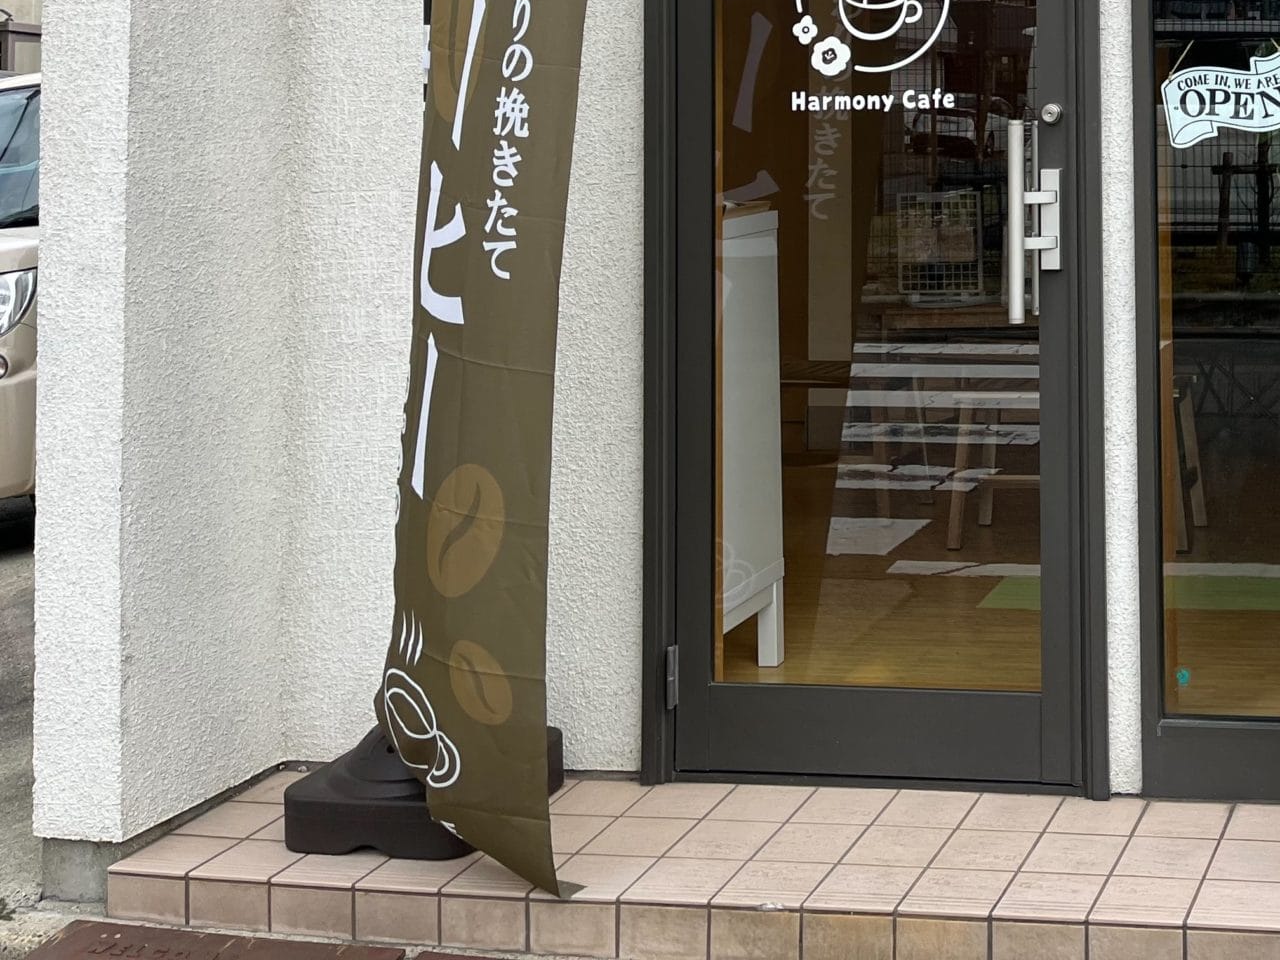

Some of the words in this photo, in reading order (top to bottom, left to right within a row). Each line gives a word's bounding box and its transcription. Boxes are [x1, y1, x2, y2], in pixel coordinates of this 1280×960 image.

[1177, 74, 1210, 91] COME
[1234, 78, 1252, 90] WE
[791, 91, 895, 112] Harmony
[902, 88, 956, 109] Cafe
